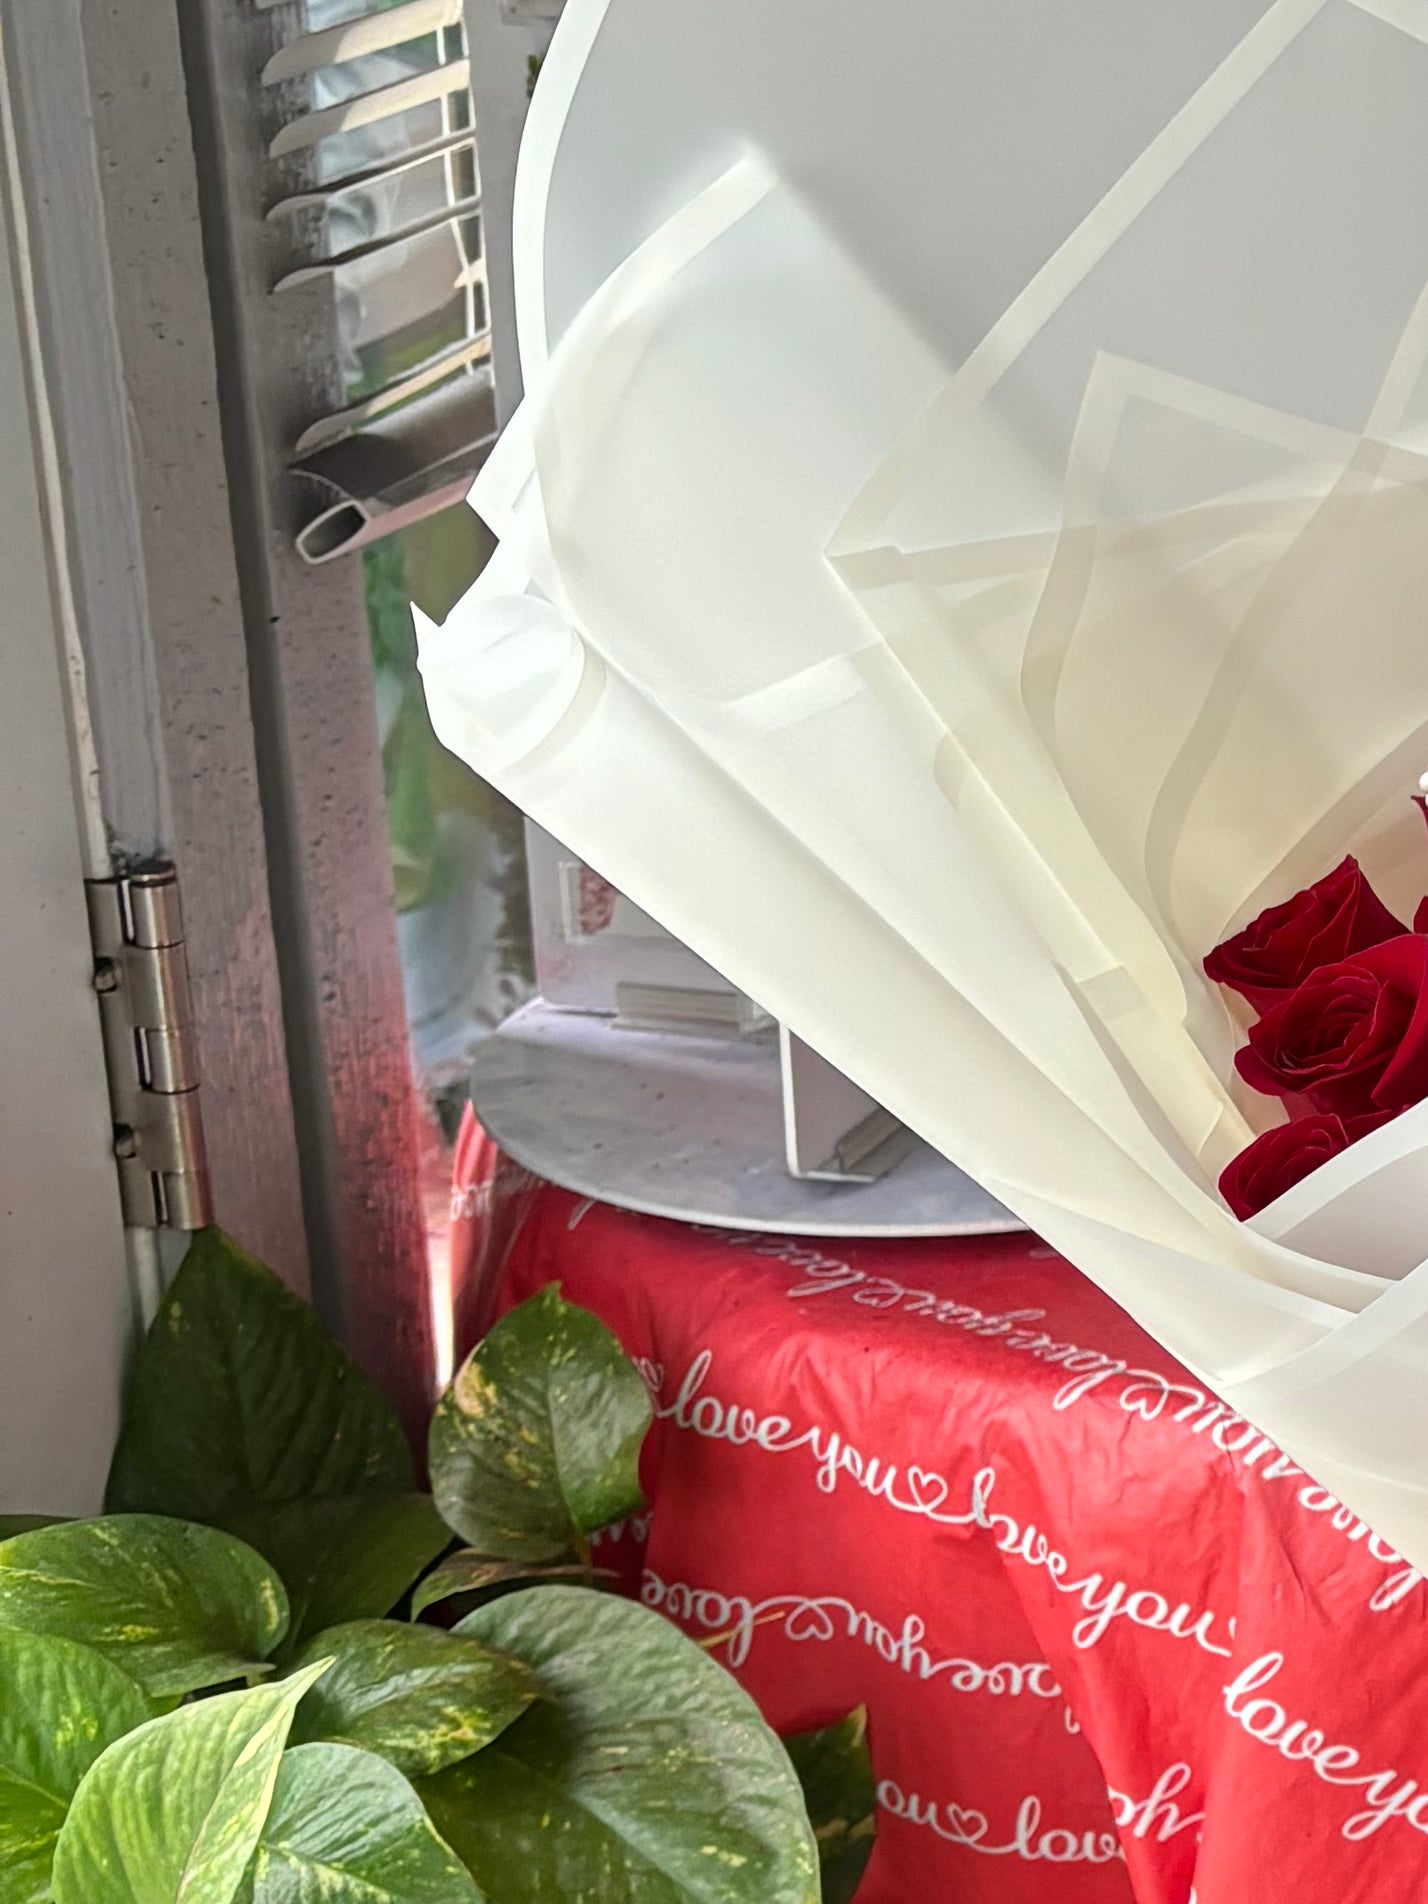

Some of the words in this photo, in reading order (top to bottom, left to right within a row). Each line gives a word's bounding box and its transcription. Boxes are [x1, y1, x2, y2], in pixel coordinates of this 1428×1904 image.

[669, 1349, 800, 1451] love
[800, 1426, 900, 1492] you
[970, 1467, 1073, 1590] love
[1072, 1572, 1236, 1656] you
[1224, 1652, 1360, 1784] love
[642, 1569, 752, 1667] love
[845, 1603, 931, 1679] you
[878, 1779, 938, 1826] ou
[1015, 1796, 1126, 1862] lov
